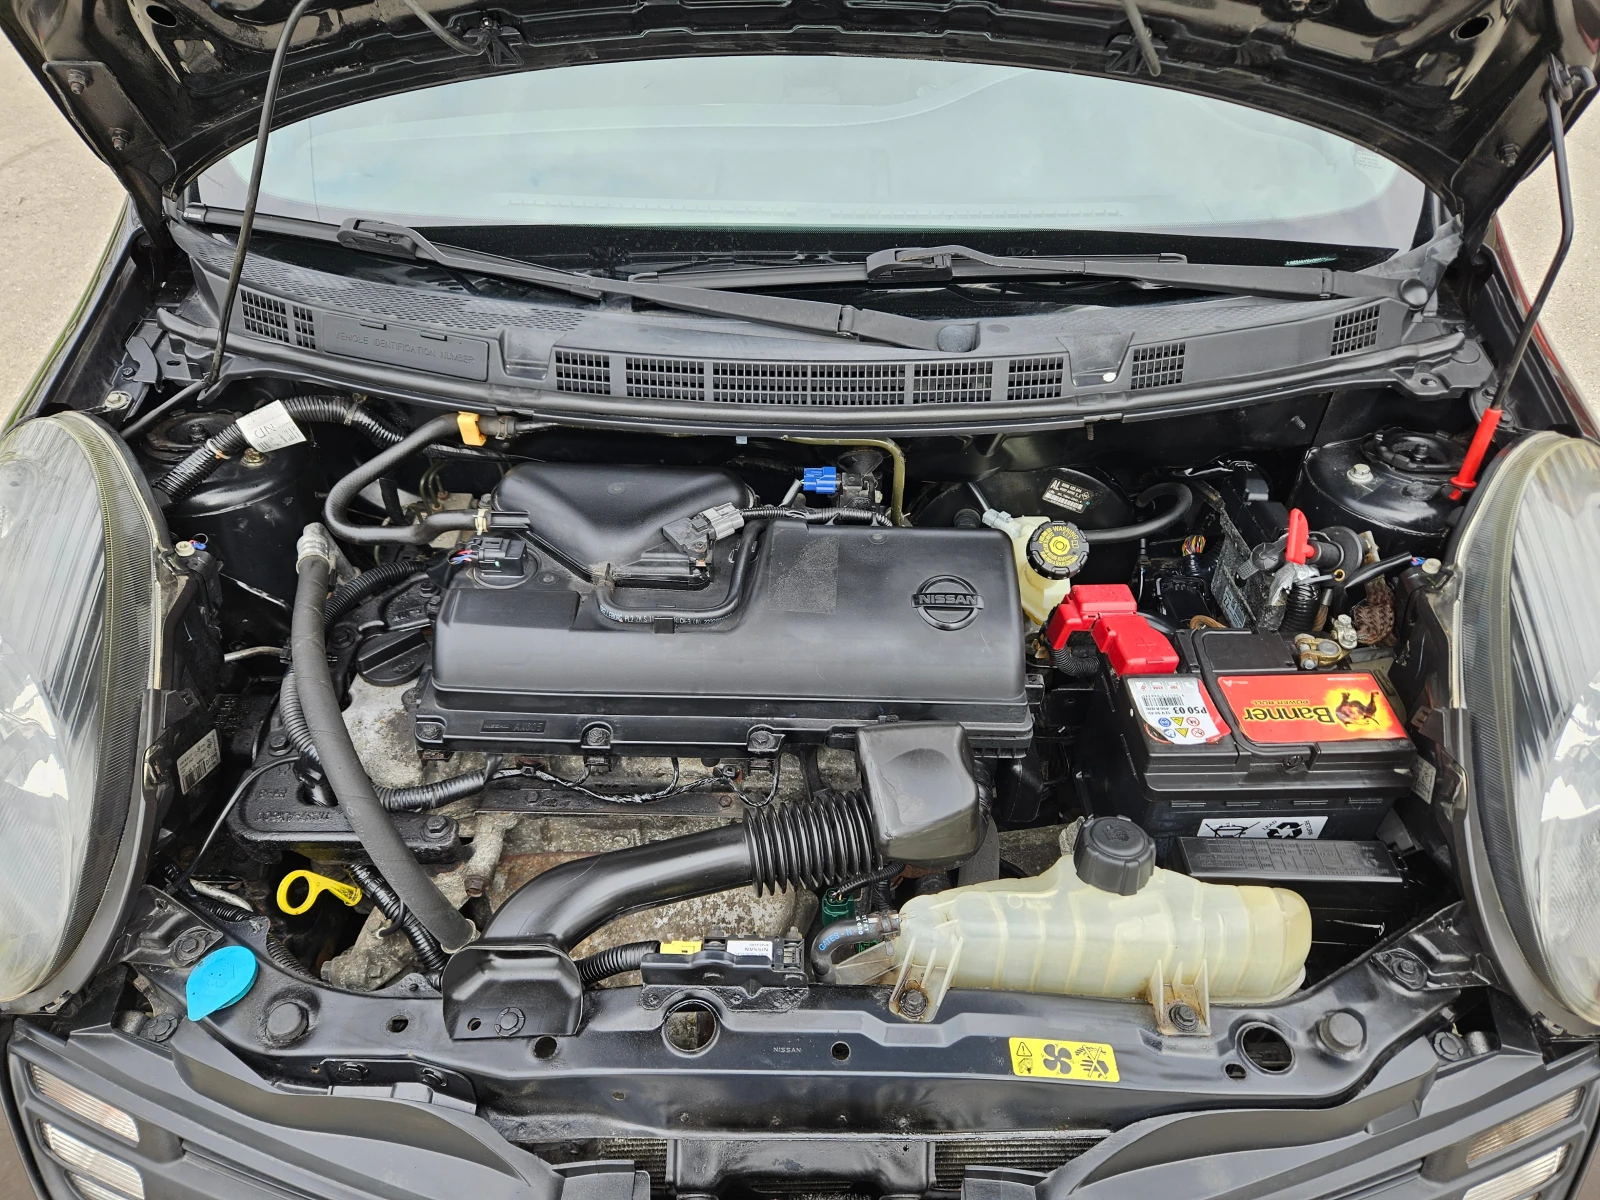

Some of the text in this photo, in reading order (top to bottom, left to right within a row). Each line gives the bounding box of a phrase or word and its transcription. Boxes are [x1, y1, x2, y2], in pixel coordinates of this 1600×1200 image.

[334, 331, 476, 365] VEHICLE IDENTIFICATION NUMBER
[918, 594, 979, 606] NISSAN
[1173, 706, 1208, 715] P50 03
[1243, 706, 1336, 724] Banner
[1262, 820, 1278, 831] LEAD
[818, 931, 841, 951] GATES
[845, 927, 853, 936] N
